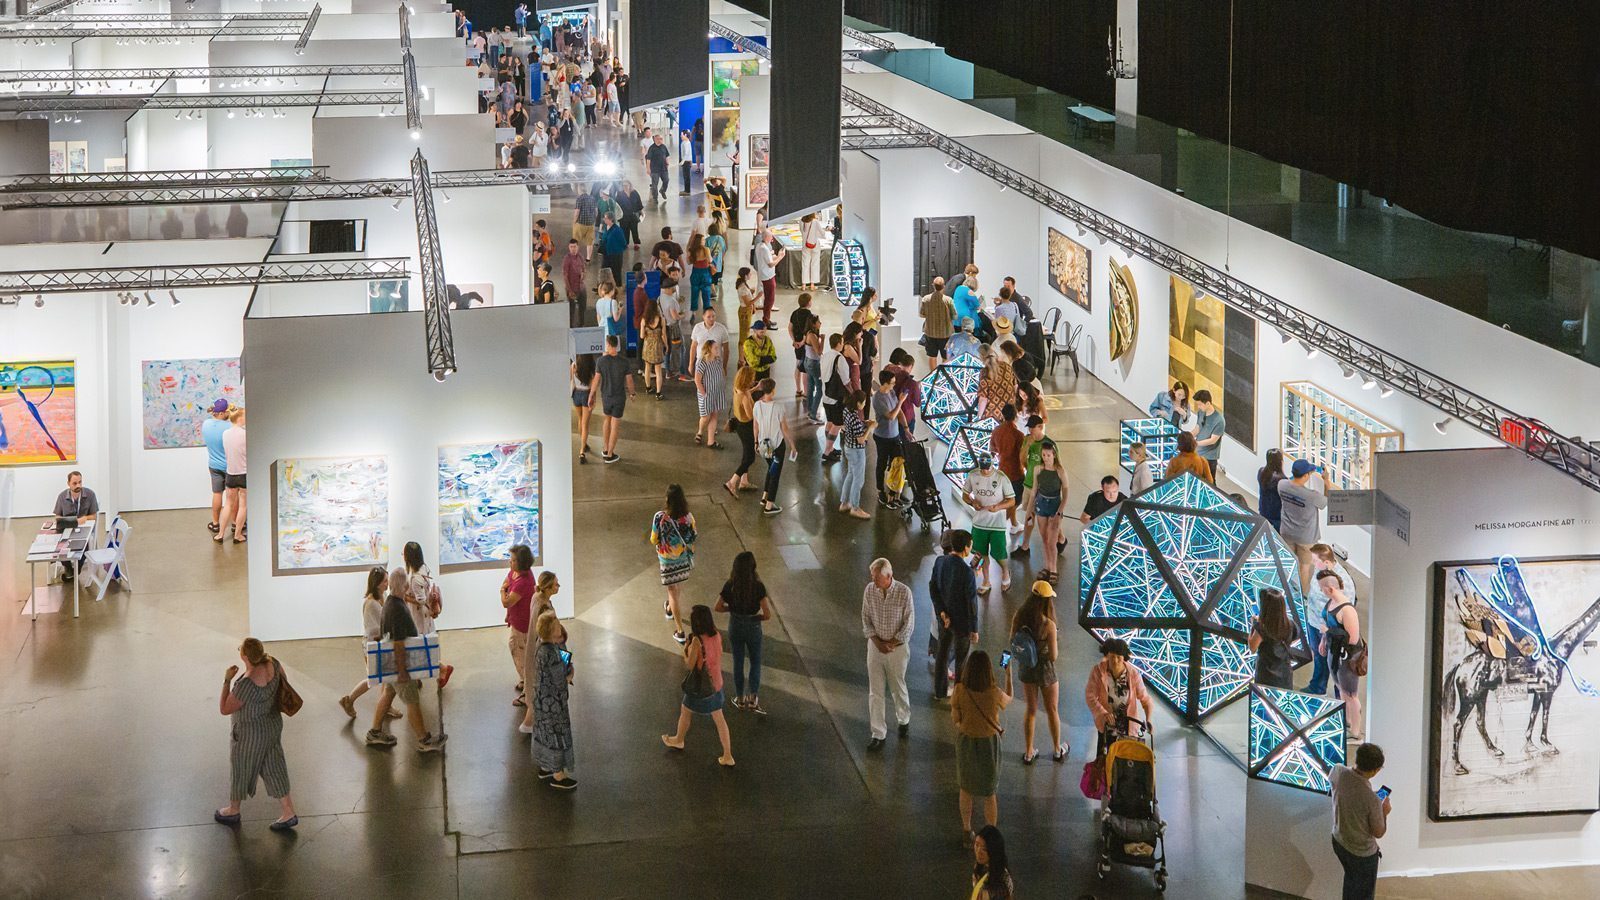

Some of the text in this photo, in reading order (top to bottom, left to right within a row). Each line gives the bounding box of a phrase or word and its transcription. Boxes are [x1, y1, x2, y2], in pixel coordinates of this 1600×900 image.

[1504, 419, 1523, 446] EXIT
[976, 489, 996, 497] XBOX
[1330, 514, 1344, 523] E11
[1475, 523, 1506, 531] MELISSA
[1507, 521, 1542, 529] MORGAN
[1543, 519, 1560, 527] FINE
[1561, 518, 1575, 526] ART
